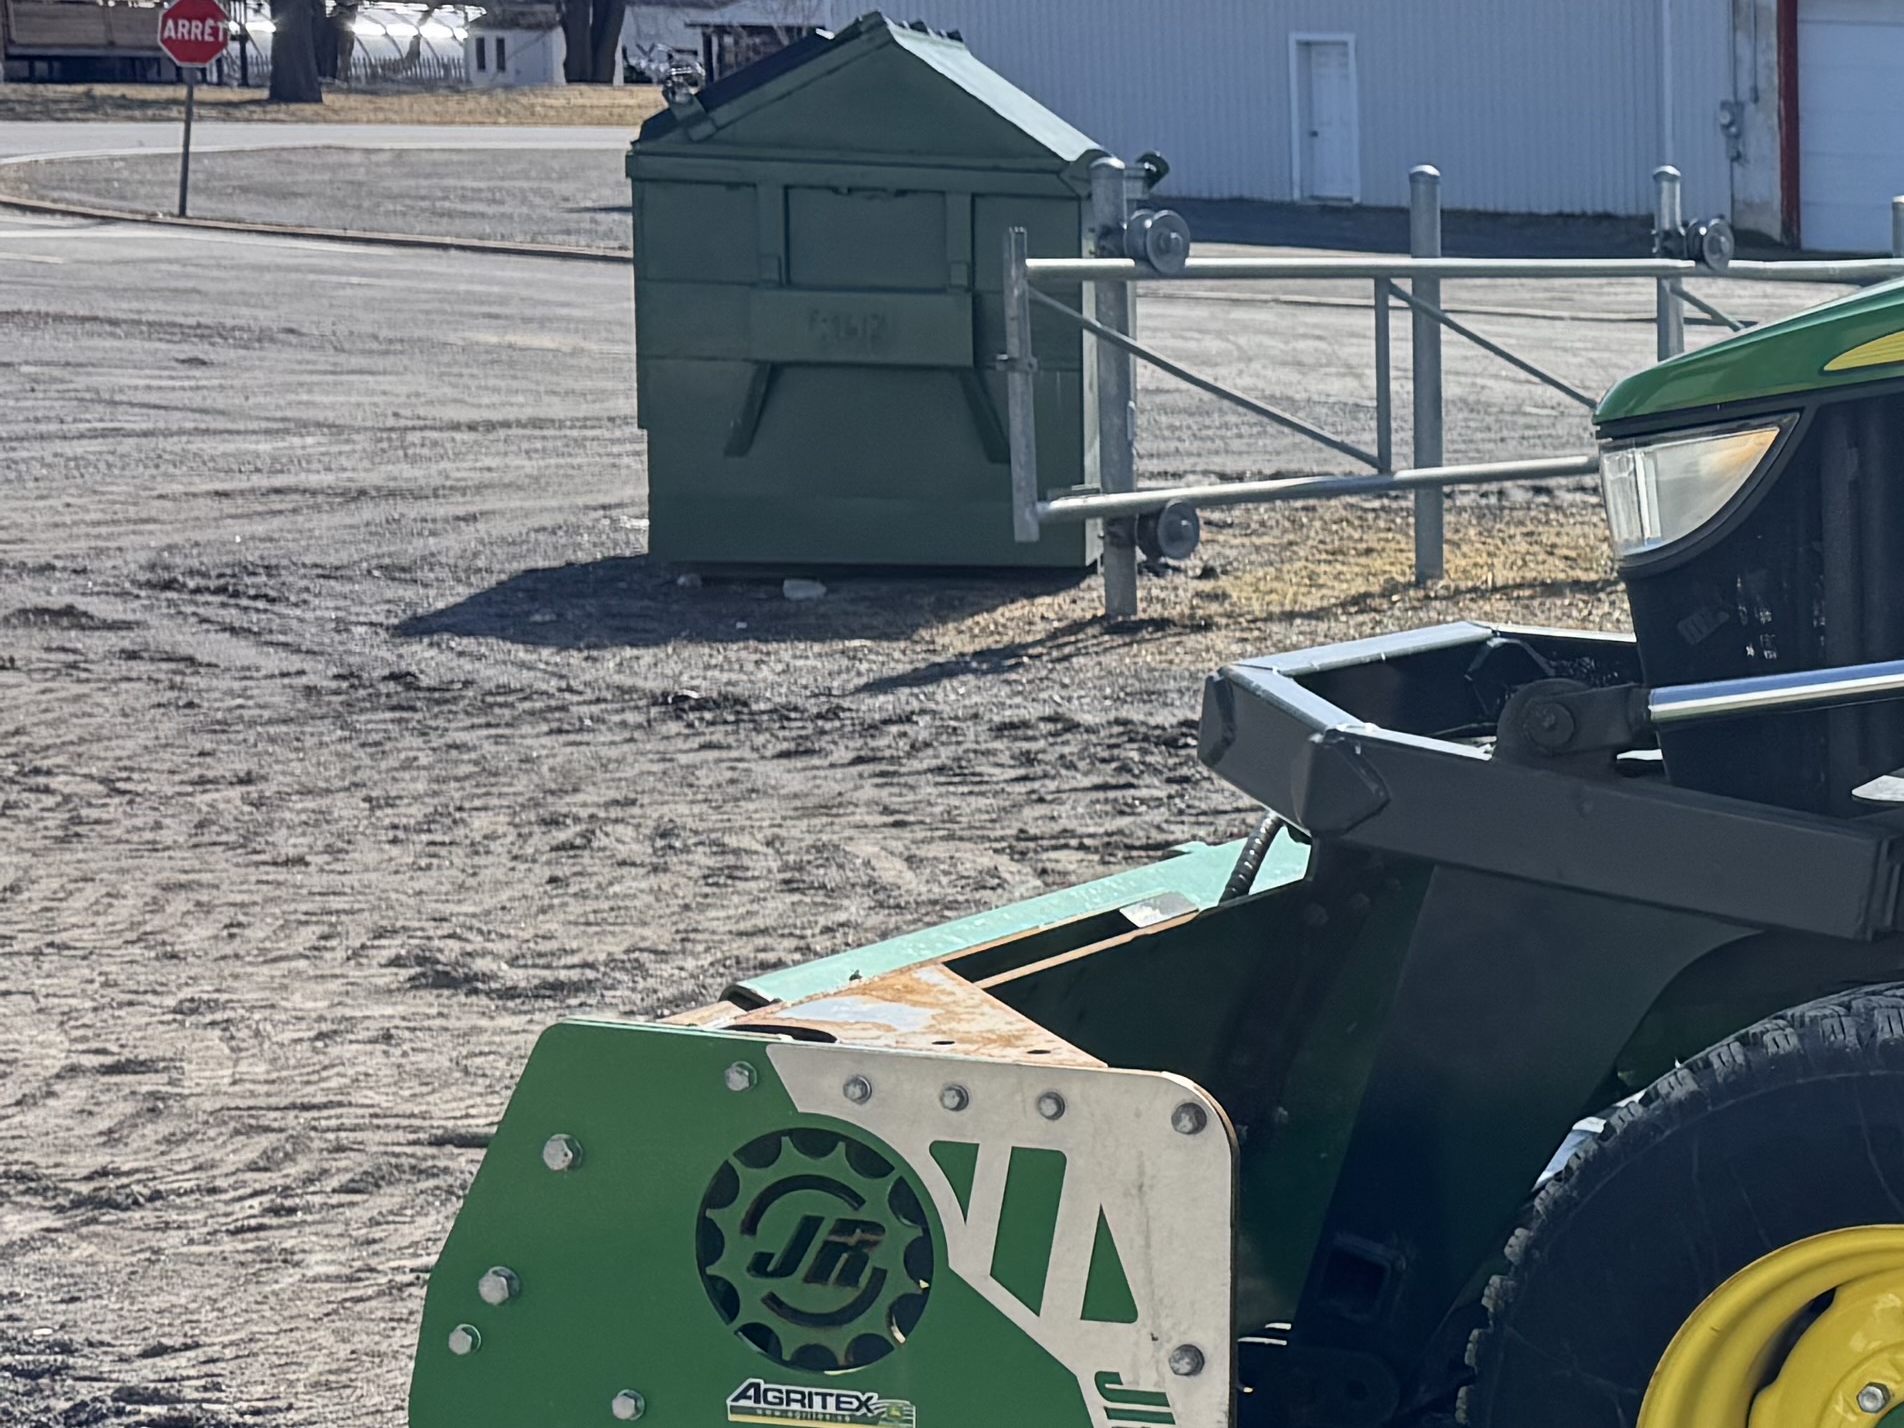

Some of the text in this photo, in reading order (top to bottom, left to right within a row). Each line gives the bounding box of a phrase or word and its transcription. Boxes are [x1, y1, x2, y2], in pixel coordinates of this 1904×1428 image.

[162, 18, 225, 42] ARRÊT
[746, 1214, 886, 1288] JR
[731, 1381, 875, 1415] AGRITEX
